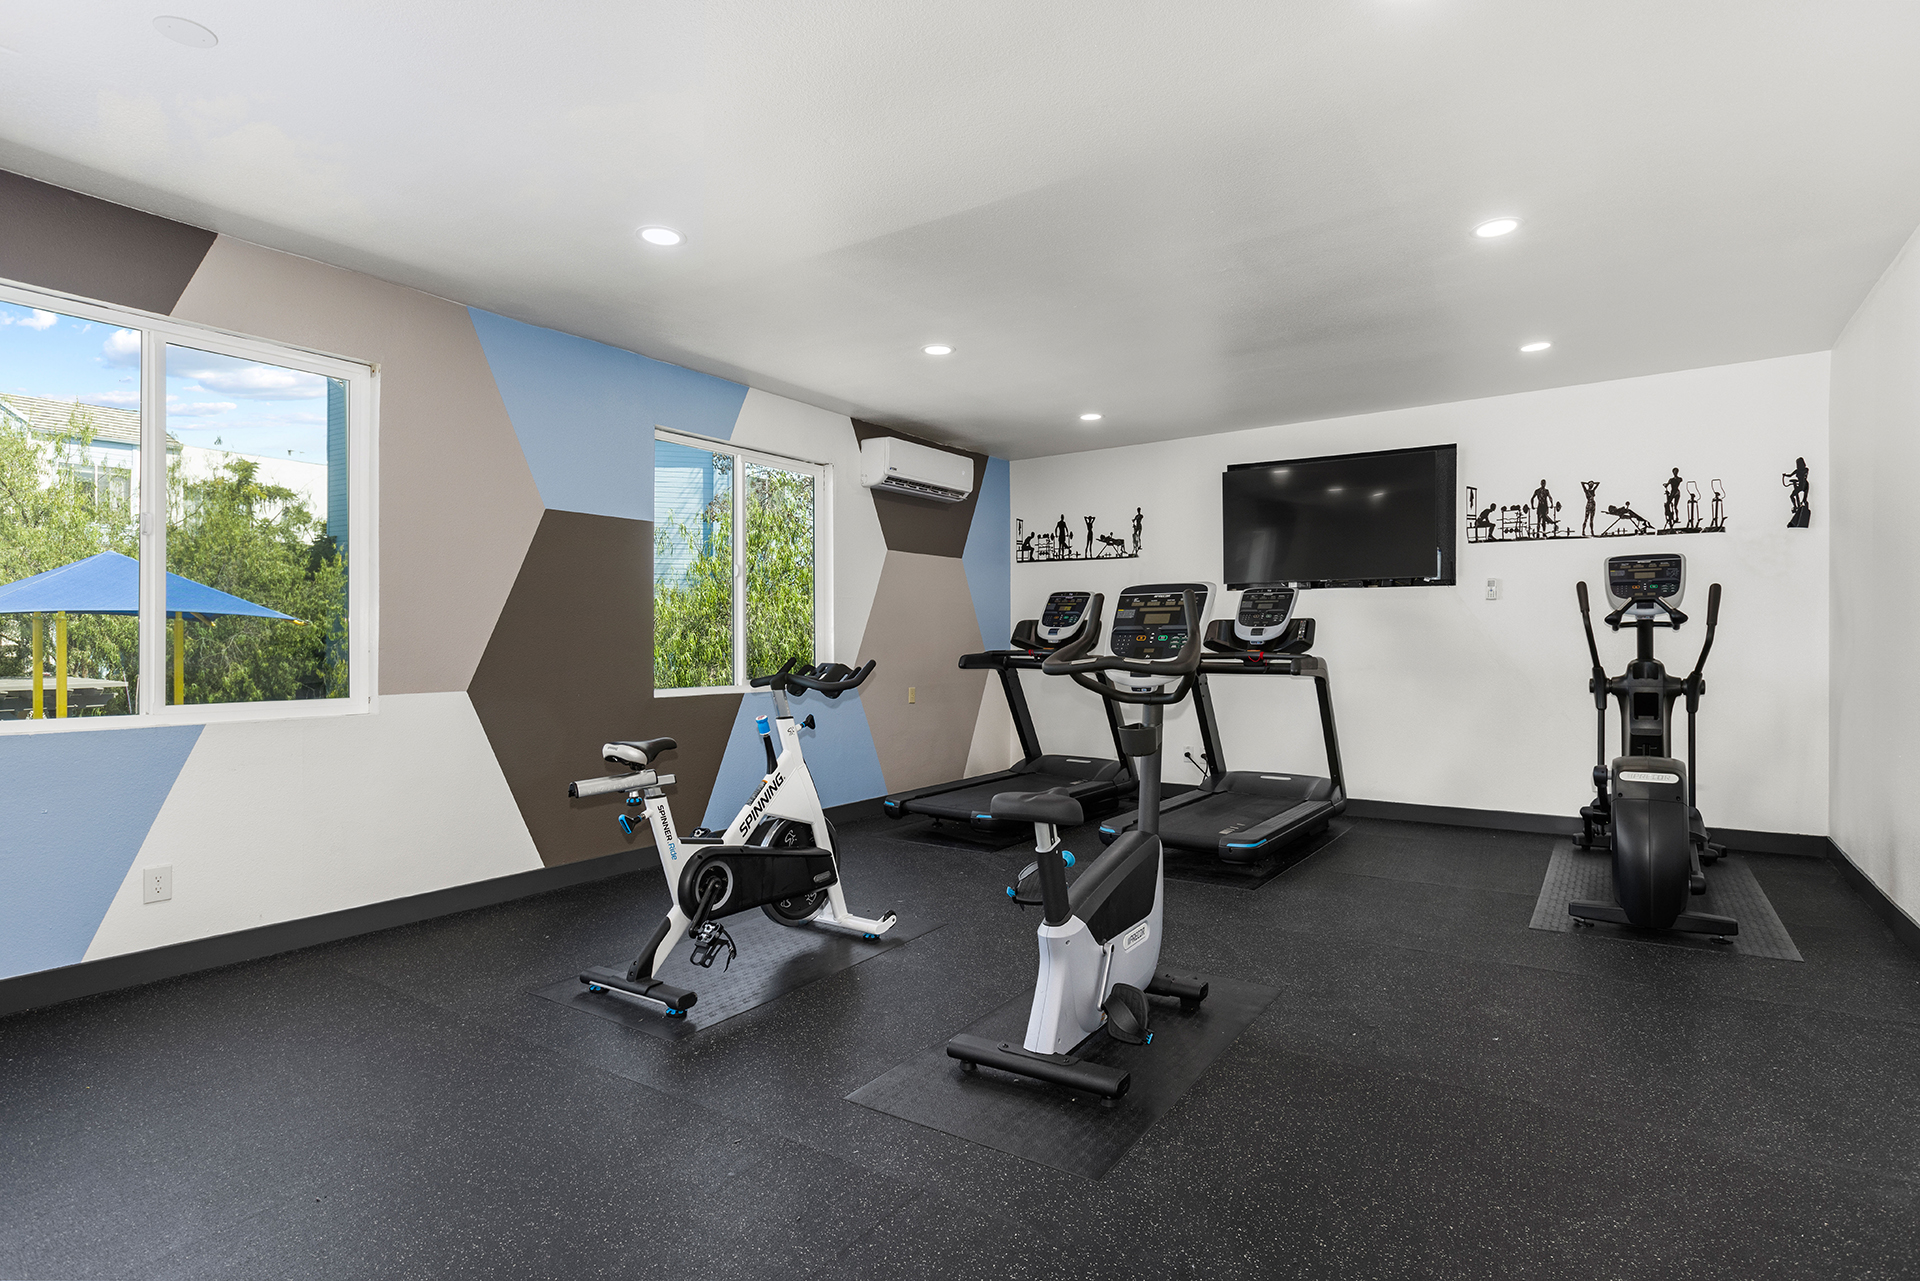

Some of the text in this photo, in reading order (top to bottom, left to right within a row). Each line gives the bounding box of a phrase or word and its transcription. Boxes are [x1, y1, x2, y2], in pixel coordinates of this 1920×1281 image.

[657, 805, 678, 860] SPINNER Ride
[739, 772, 784, 837] SPINNING
